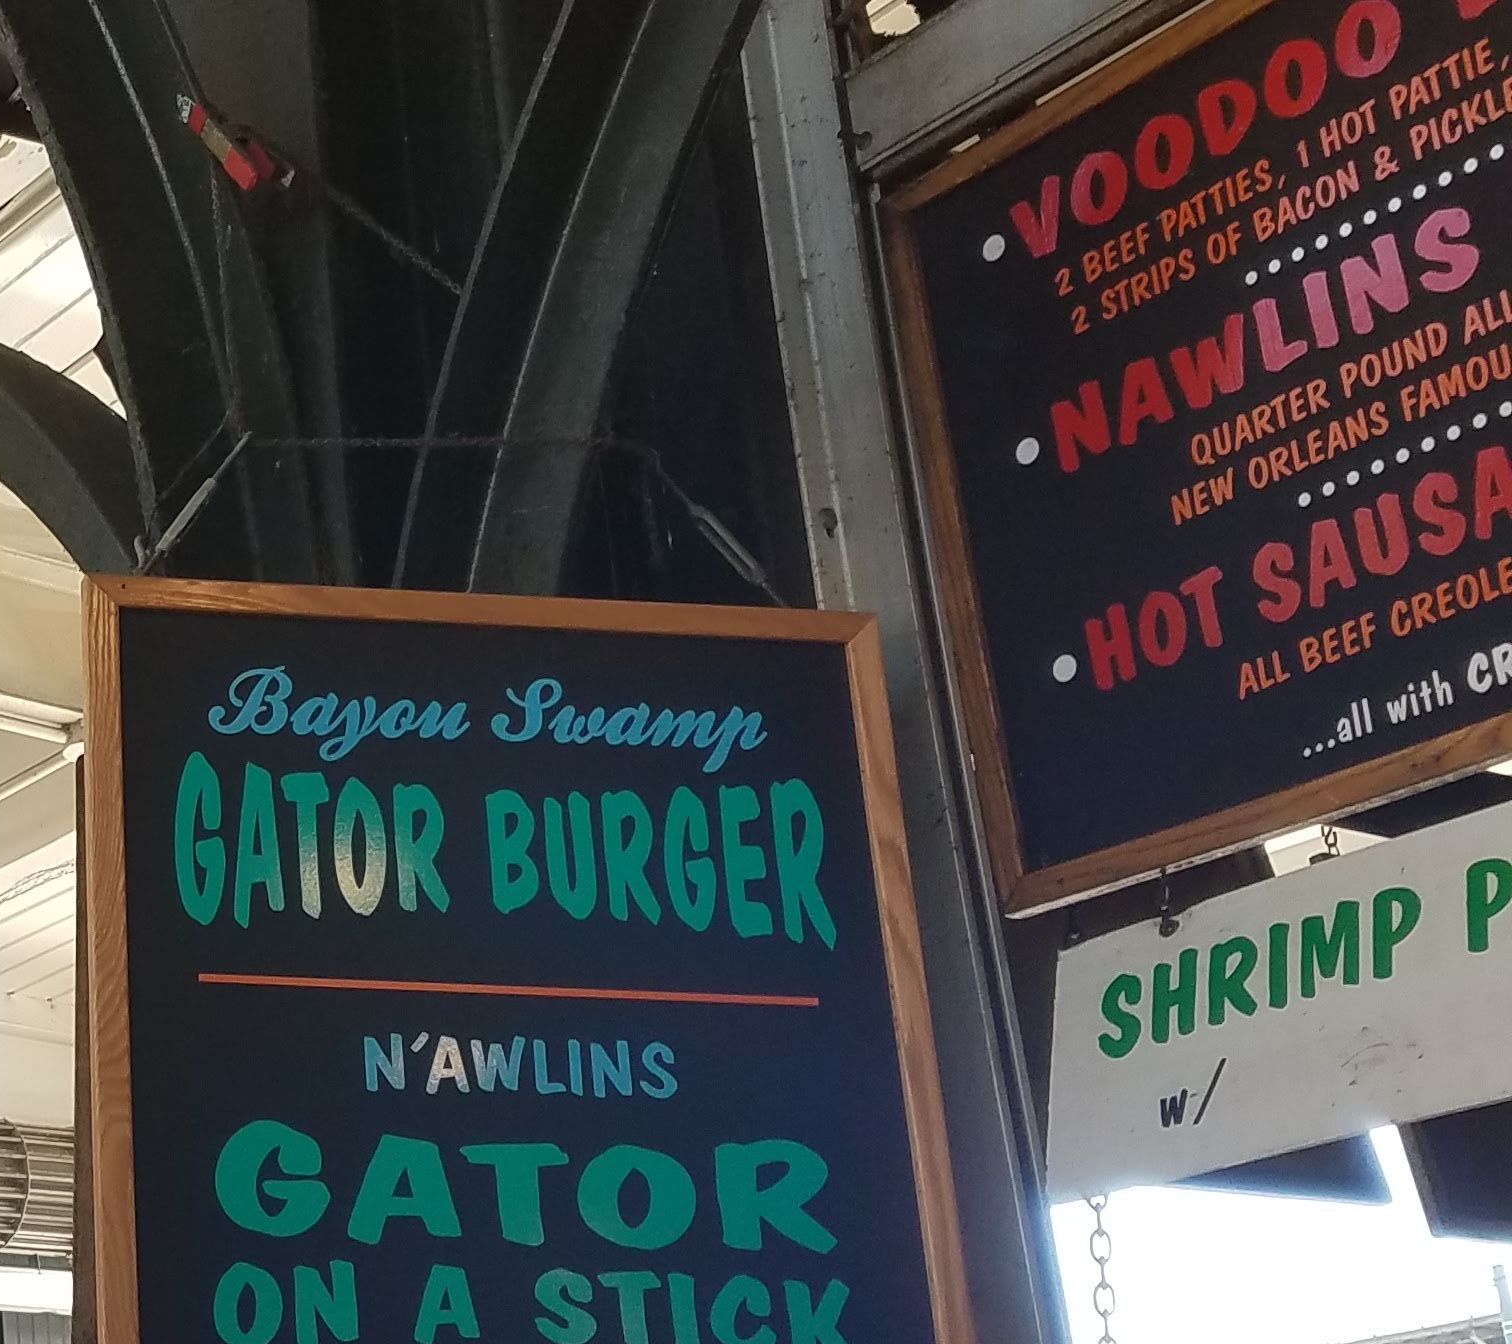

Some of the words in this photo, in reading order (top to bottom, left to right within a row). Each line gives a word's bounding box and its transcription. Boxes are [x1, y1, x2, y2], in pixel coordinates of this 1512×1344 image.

[1054, 266, 1073, 298] 2
[1082, 222, 1149, 285] BEEF
[1159, 157, 1290, 242] PATTIES,
[1296, 139, 1310, 170] 1
[1318, 98, 1377, 159] HOT
[1388, 36, 1510, 122] PATTIE,
[1071, 304, 1091, 335] 2
[1099, 246, 1196, 322] STRIPS
[1206, 219, 1245, 265] OF
[1252, 160, 1361, 242] BACON
[1374, 144, 1401, 183] &
[1050, 207, 1480, 472] NAWLINS
[1190, 378, 1331, 467] QUARTER
[1340, 321, 1448, 398] POUND
[1170, 475, 1235, 526] NEW
[1249, 402, 1390, 490] ORLEANS
[1400, 343, 1512, 423] FAMOU
[1084, 565, 1223, 691] HOT
[1252, 445, 1512, 623] SAUSA
[1239, 657, 1292, 700] ALL
[1299, 612, 1378, 674] BEEF
[1390, 556, 1512, 636] CREOLE
[209, 665, 471, 762] Bayou
[491, 678, 768, 773] Swamp
[1385, 670, 1454, 725] with
[174, 752, 450, 928] GATOR
[485, 778, 837, 950] BURGER
[1098, 886, 1422, 1060] SHRIMP
[364, 1032, 679, 1100] N'AWLINS
[1159, 1057, 1227, 1130] w/
[215, 1119, 839, 1255] GATOR
